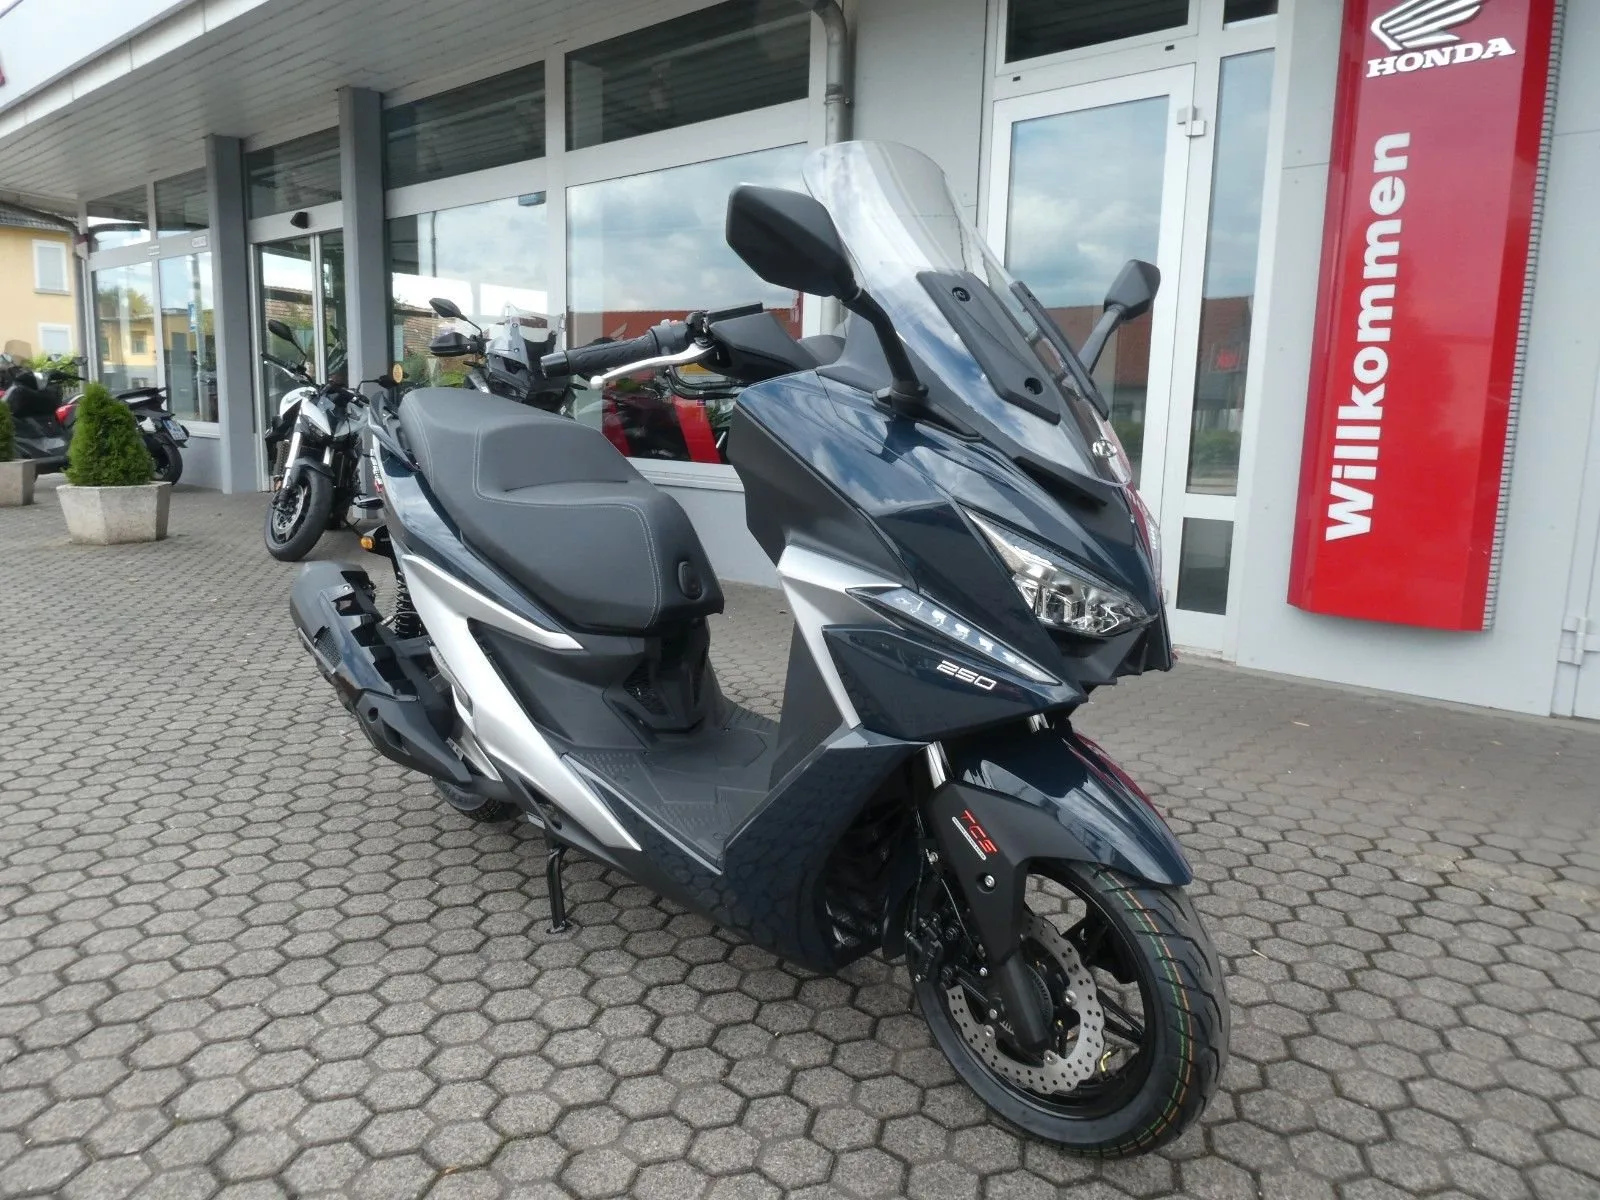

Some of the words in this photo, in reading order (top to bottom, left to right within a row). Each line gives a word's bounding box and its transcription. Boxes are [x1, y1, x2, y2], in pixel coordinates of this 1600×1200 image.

[1366, 37, 1516, 78] HONDA
[1325, 132, 1411, 541] Willkommen
[936, 659, 997, 690] 250
[960, 808, 998, 854] TCS
